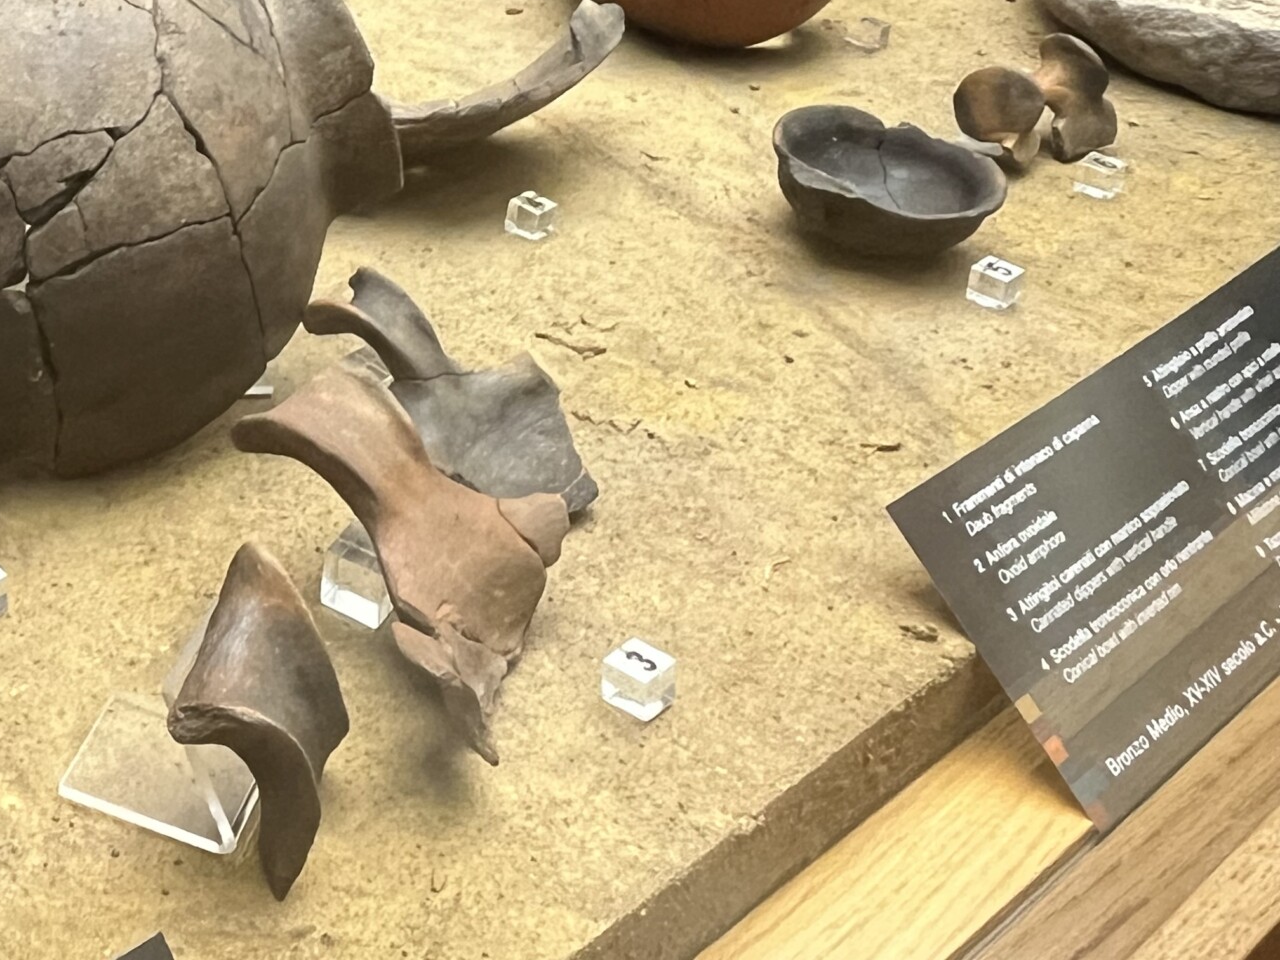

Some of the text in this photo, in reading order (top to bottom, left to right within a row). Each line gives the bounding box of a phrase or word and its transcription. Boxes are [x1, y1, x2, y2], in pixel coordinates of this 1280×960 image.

[984, 261, 1013, 276] 5
[942, 510, 953, 524] 1
[973, 558, 987, 574] 2
[985, 536, 1021, 566] Anfora
[1005, 606, 1019, 623] 3
[625, 650, 658, 672] 3
[1104, 734, 1150, 777] Bronzo
[1146, 704, 1190, 742] Medio,
[1182, 664, 1222, 708] XV-XIV
[1220, 639, 1257, 676] secolo
